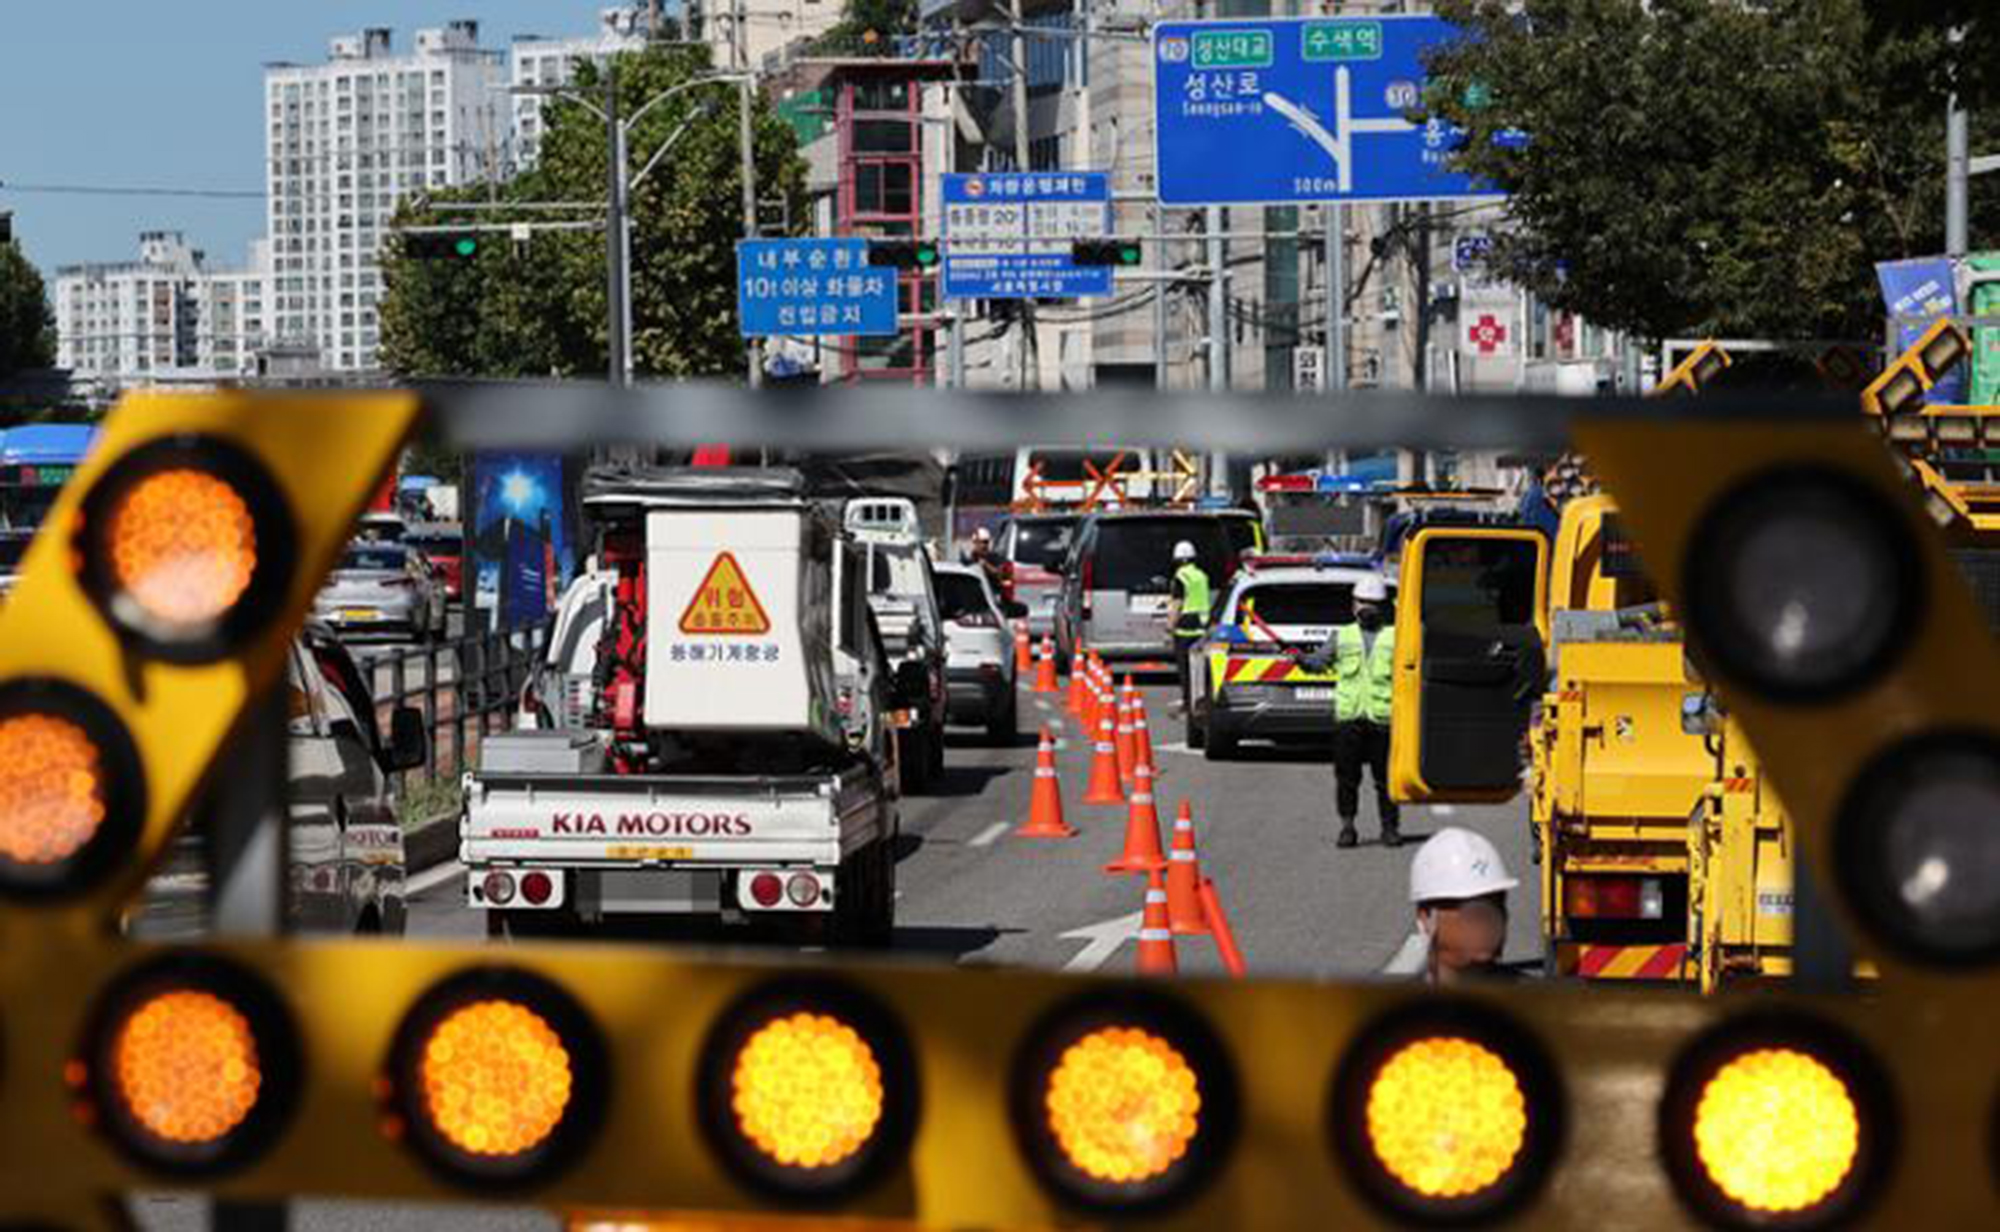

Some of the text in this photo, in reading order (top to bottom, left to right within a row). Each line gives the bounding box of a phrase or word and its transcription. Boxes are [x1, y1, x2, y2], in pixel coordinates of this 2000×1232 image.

[1308, 27, 1376, 52] 수색역
[1183, 72, 1261, 101] 성산로
[778, 304, 862, 325] 진입금지
[705, 587, 745, 609] 위험
[552, 813, 606, 834] KIA
[616, 812, 752, 836] MOTORS
